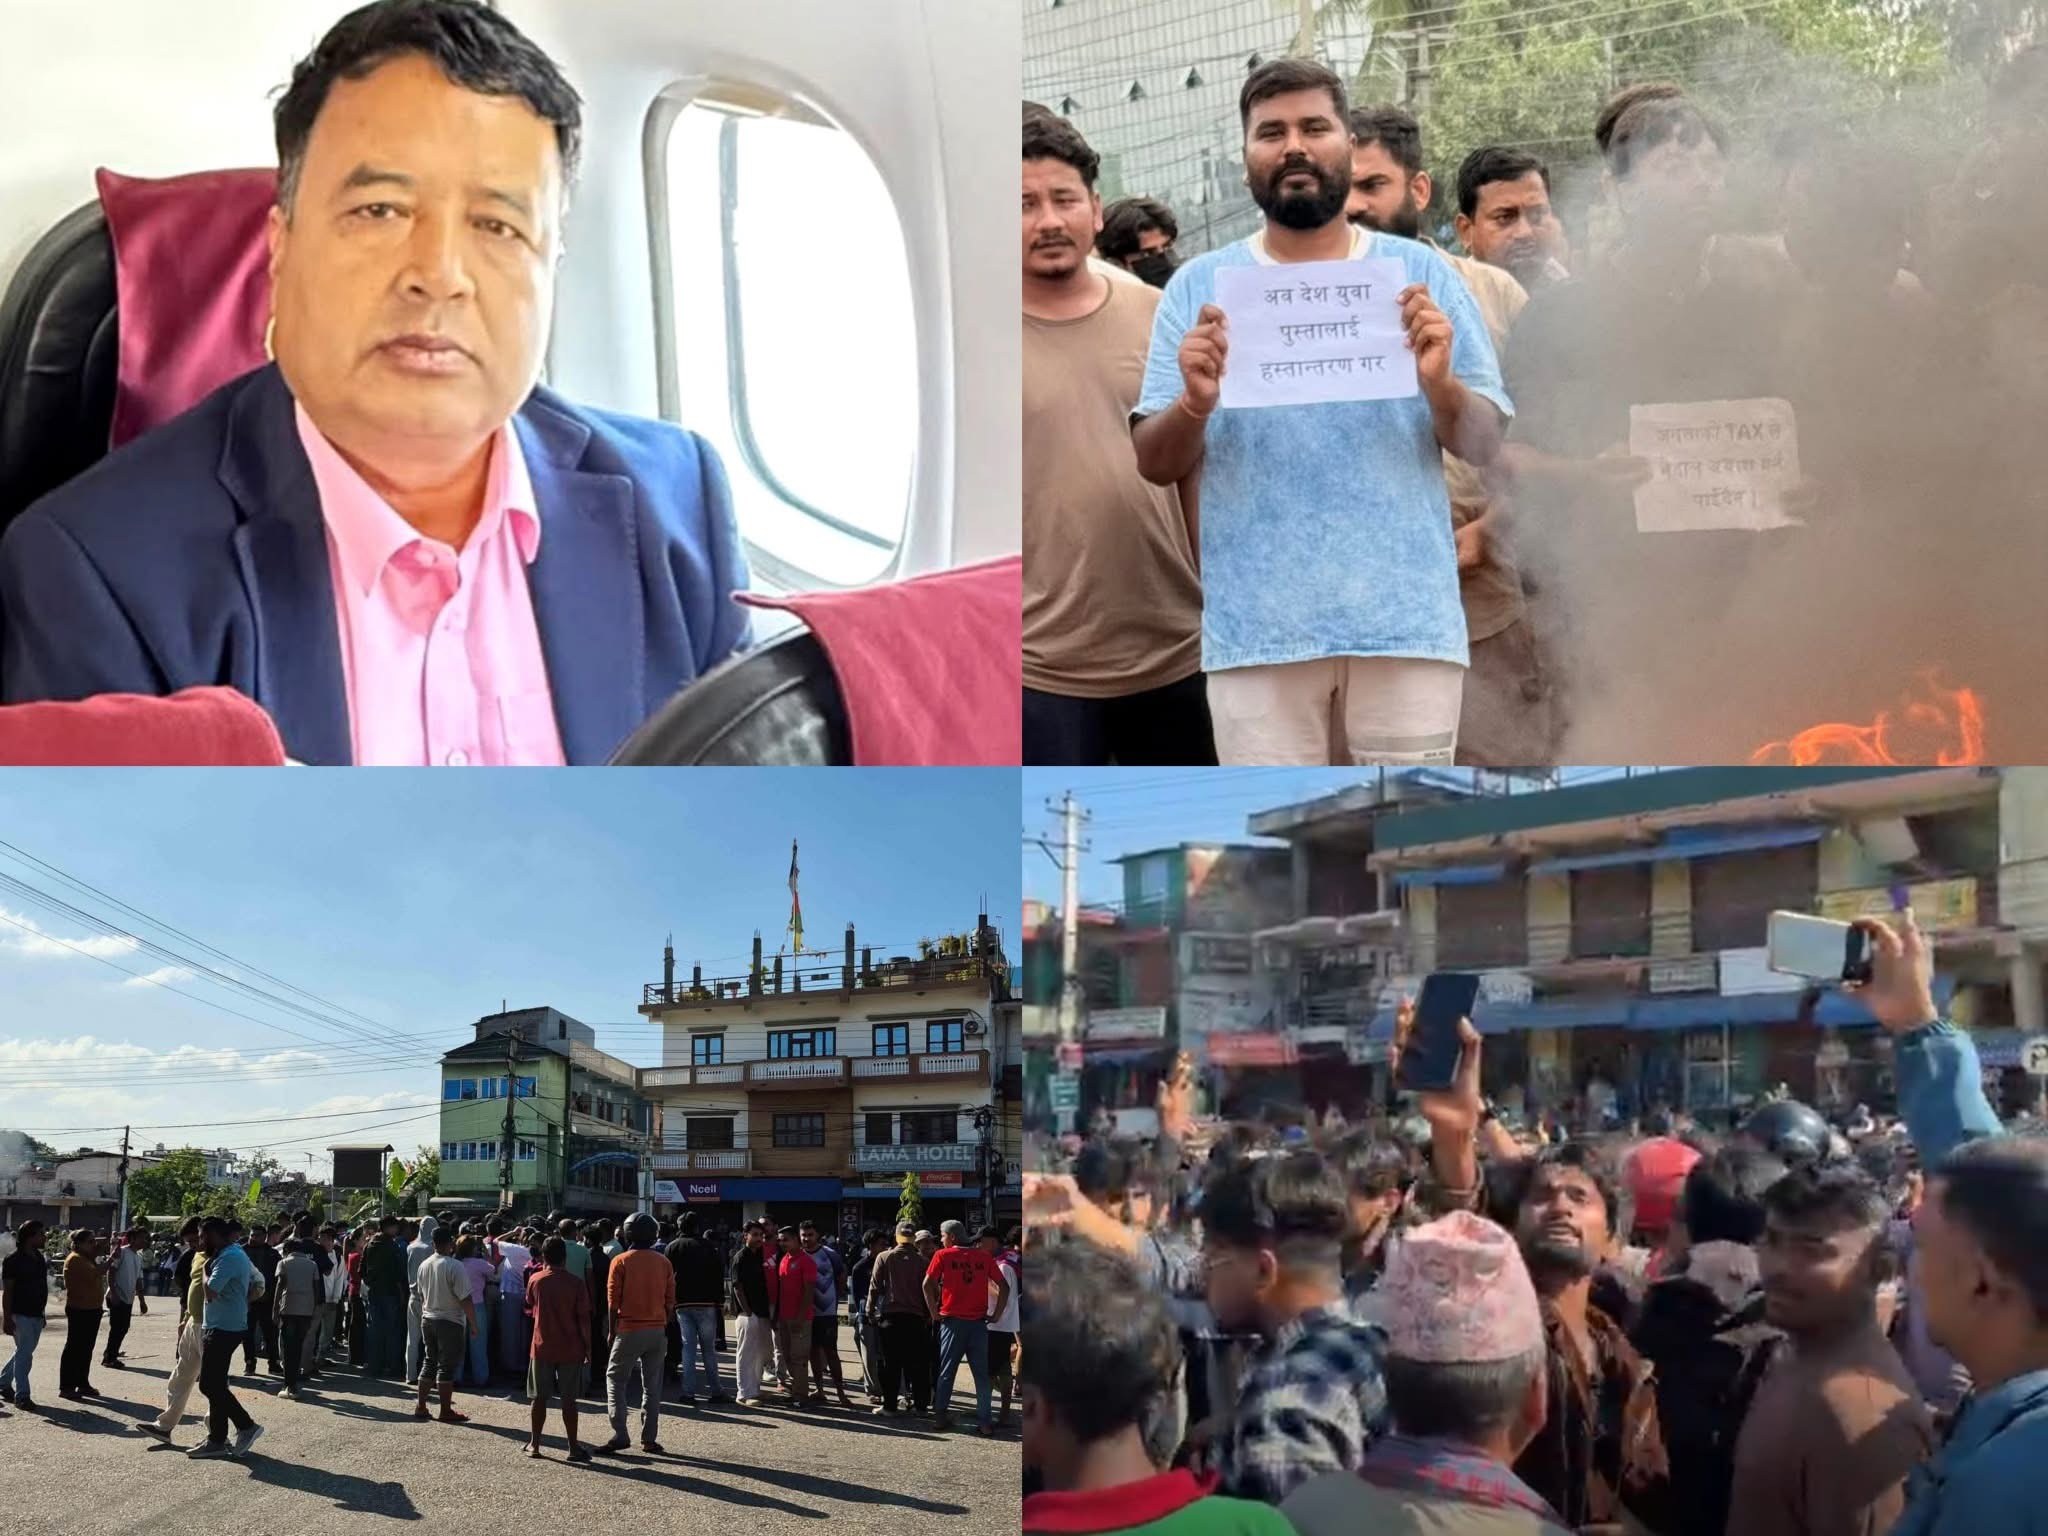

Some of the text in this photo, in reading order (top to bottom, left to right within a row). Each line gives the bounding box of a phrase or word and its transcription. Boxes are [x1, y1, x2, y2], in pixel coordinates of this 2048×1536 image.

[1299, 281, 1329, 304] देश
[1335, 284, 1373, 308] युवा
[1279, 315, 1361, 347] पुस्तालाई
[1259, 355, 1387, 384] हस्तान्तरण गर
[1725, 422, 1764, 441] TAX
[858, 1146, 973, 1162] LAMA HOTEL
[689, 1183, 717, 1194] Ncell
